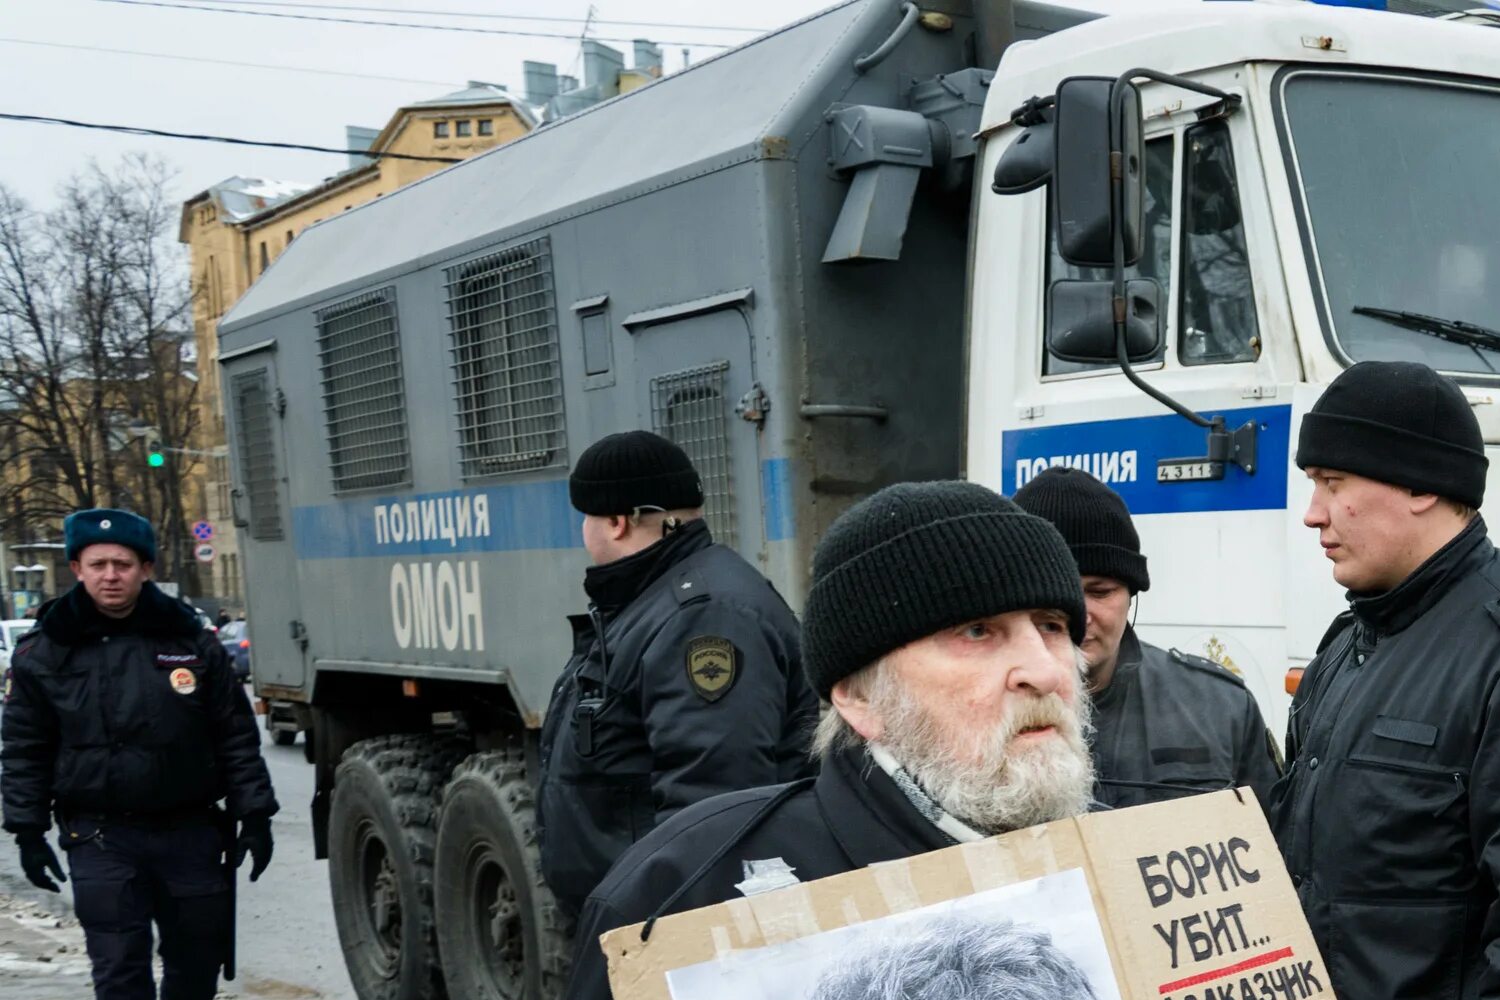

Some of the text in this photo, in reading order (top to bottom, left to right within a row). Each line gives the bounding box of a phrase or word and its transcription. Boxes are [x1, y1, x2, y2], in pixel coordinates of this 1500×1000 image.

[374, 494, 490, 547] ПОЛИЦИЯ
[390, 560, 485, 651] ОМОН
[1136, 836, 1261, 908] БОРИС
[1153, 902, 1271, 969] УБИТ...
